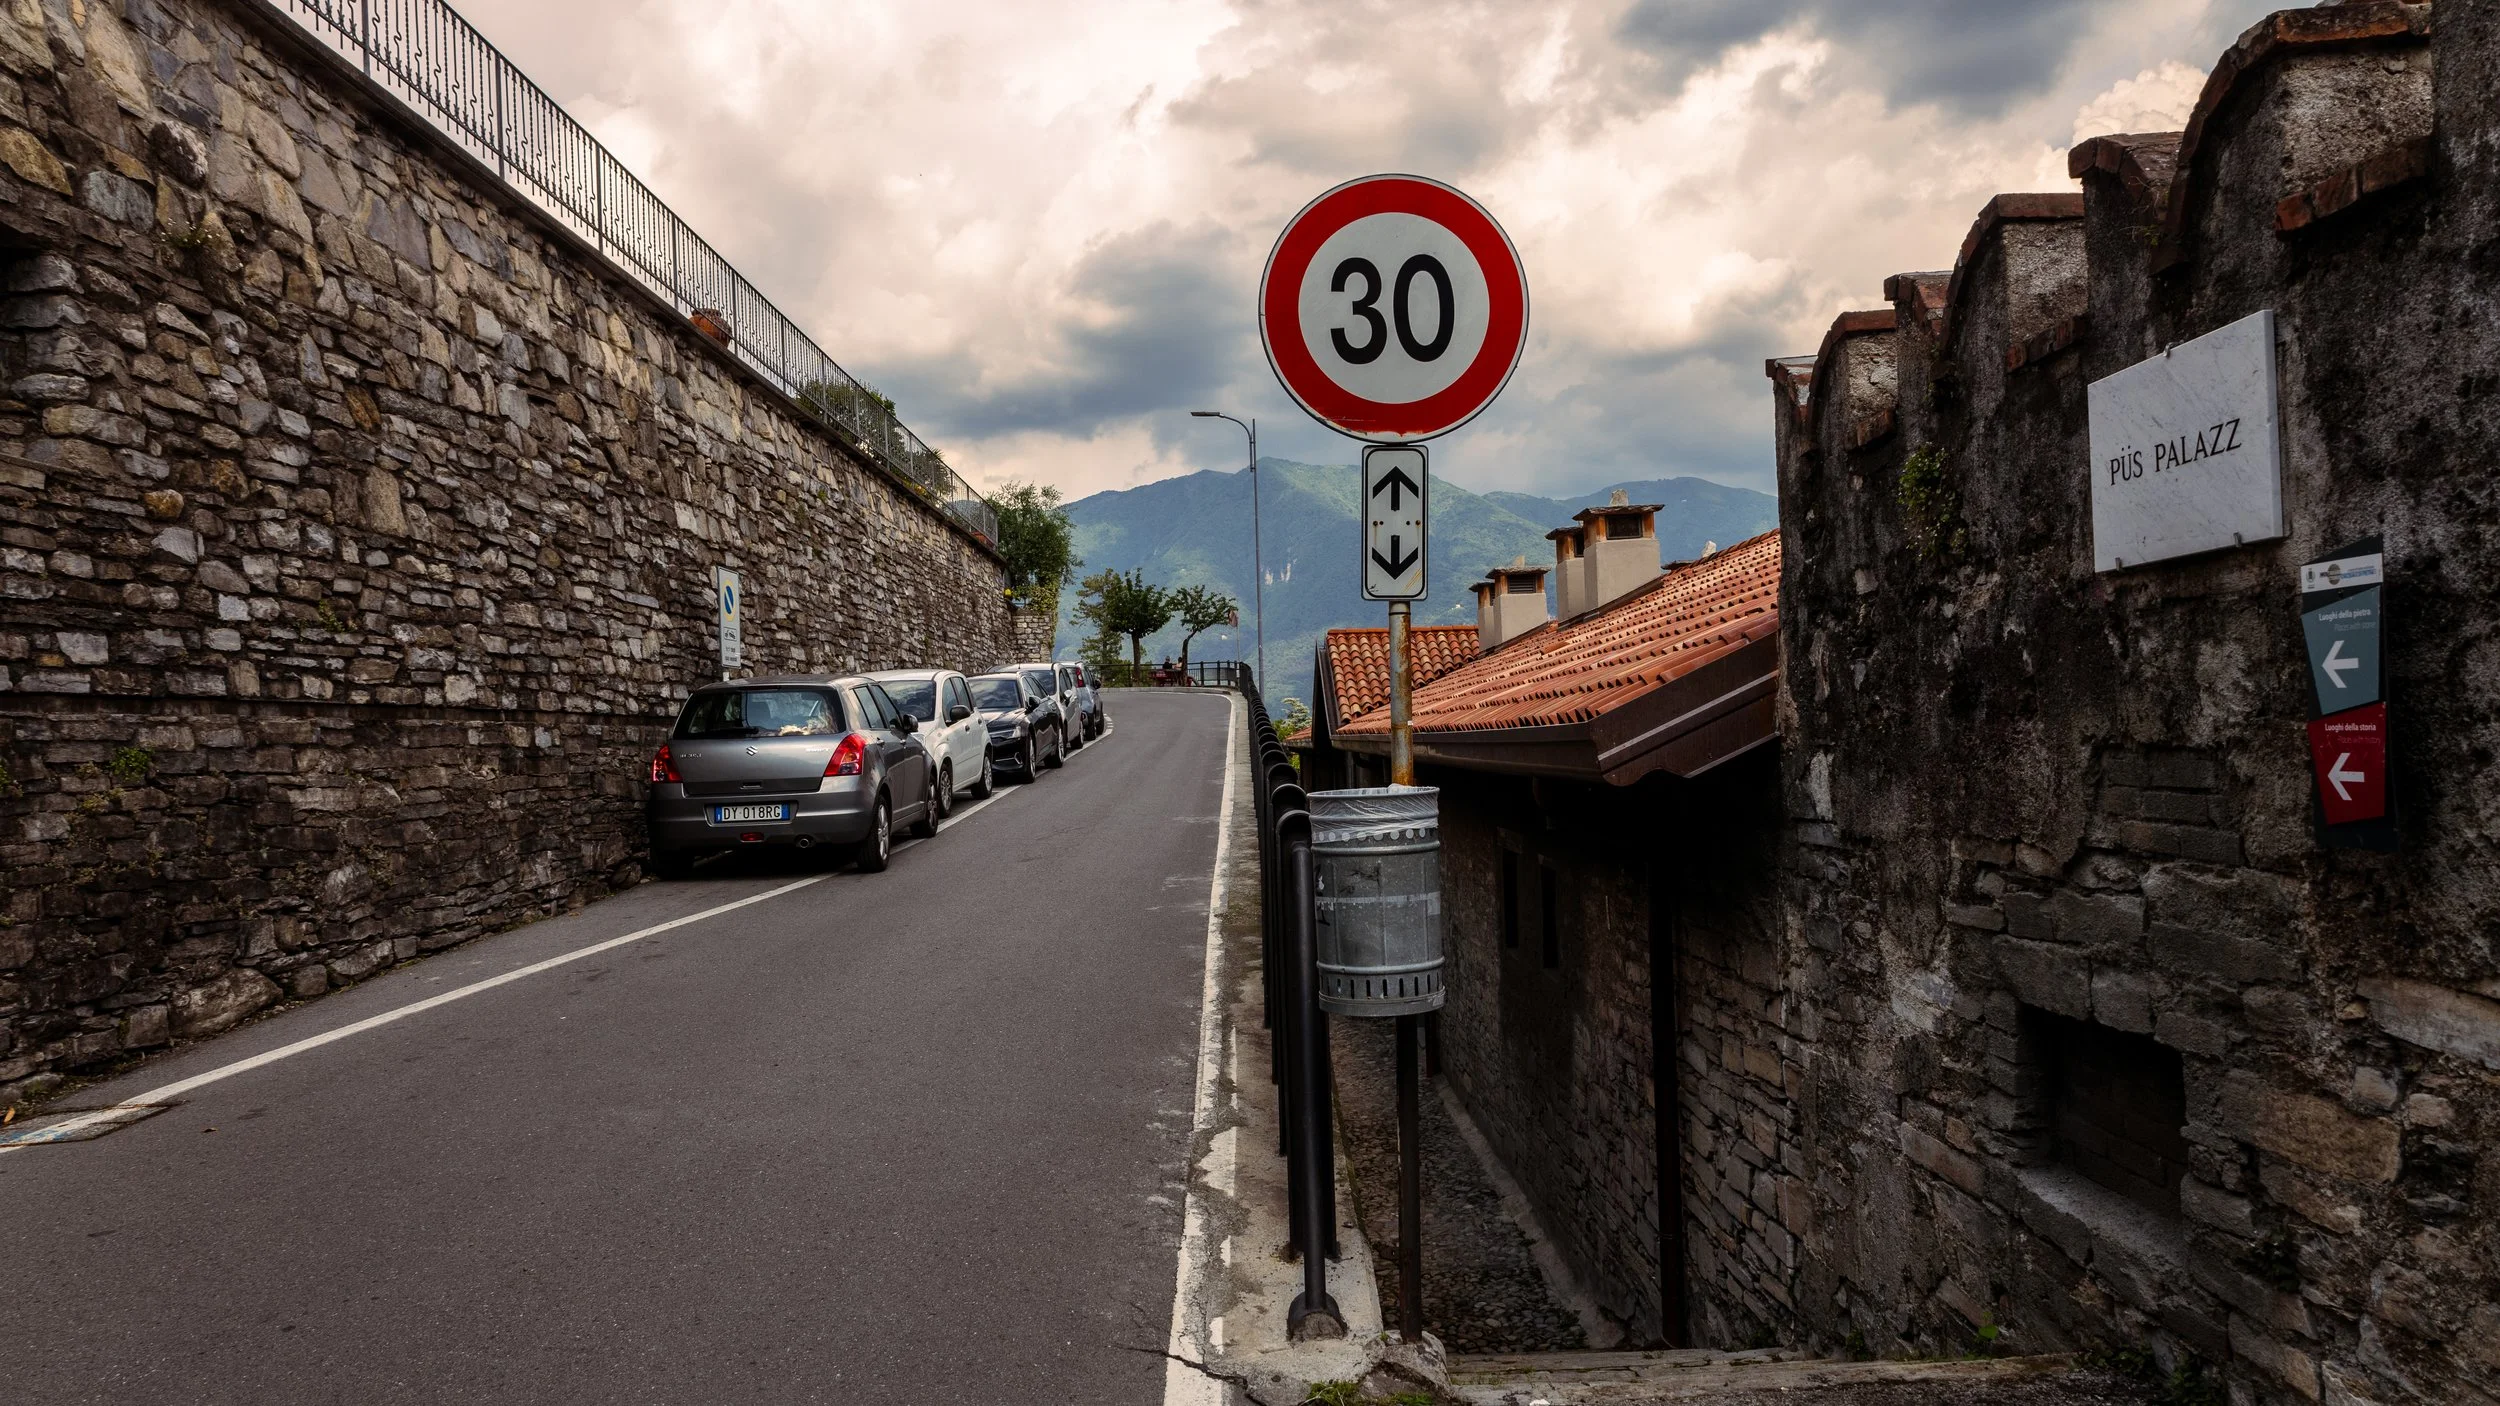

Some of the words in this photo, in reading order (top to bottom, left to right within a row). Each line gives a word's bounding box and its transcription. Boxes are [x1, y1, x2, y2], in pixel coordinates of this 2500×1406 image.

[1330, 253, 1455, 365] 30
[2109, 445, 2143, 486] PÜS
[2154, 418, 2242, 473] PALAZZ
[2318, 611, 2338, 623] Luoghi
[2338, 609, 2353, 619] della
[2353, 608, 2371, 620] pietra
[2324, 723, 2344, 733] Luoghi
[2344, 722, 2359, 731] della
[2359, 722, 2376, 731] storia
[723, 807, 738, 820] DY
[742, 805, 781, 819] 018RG
